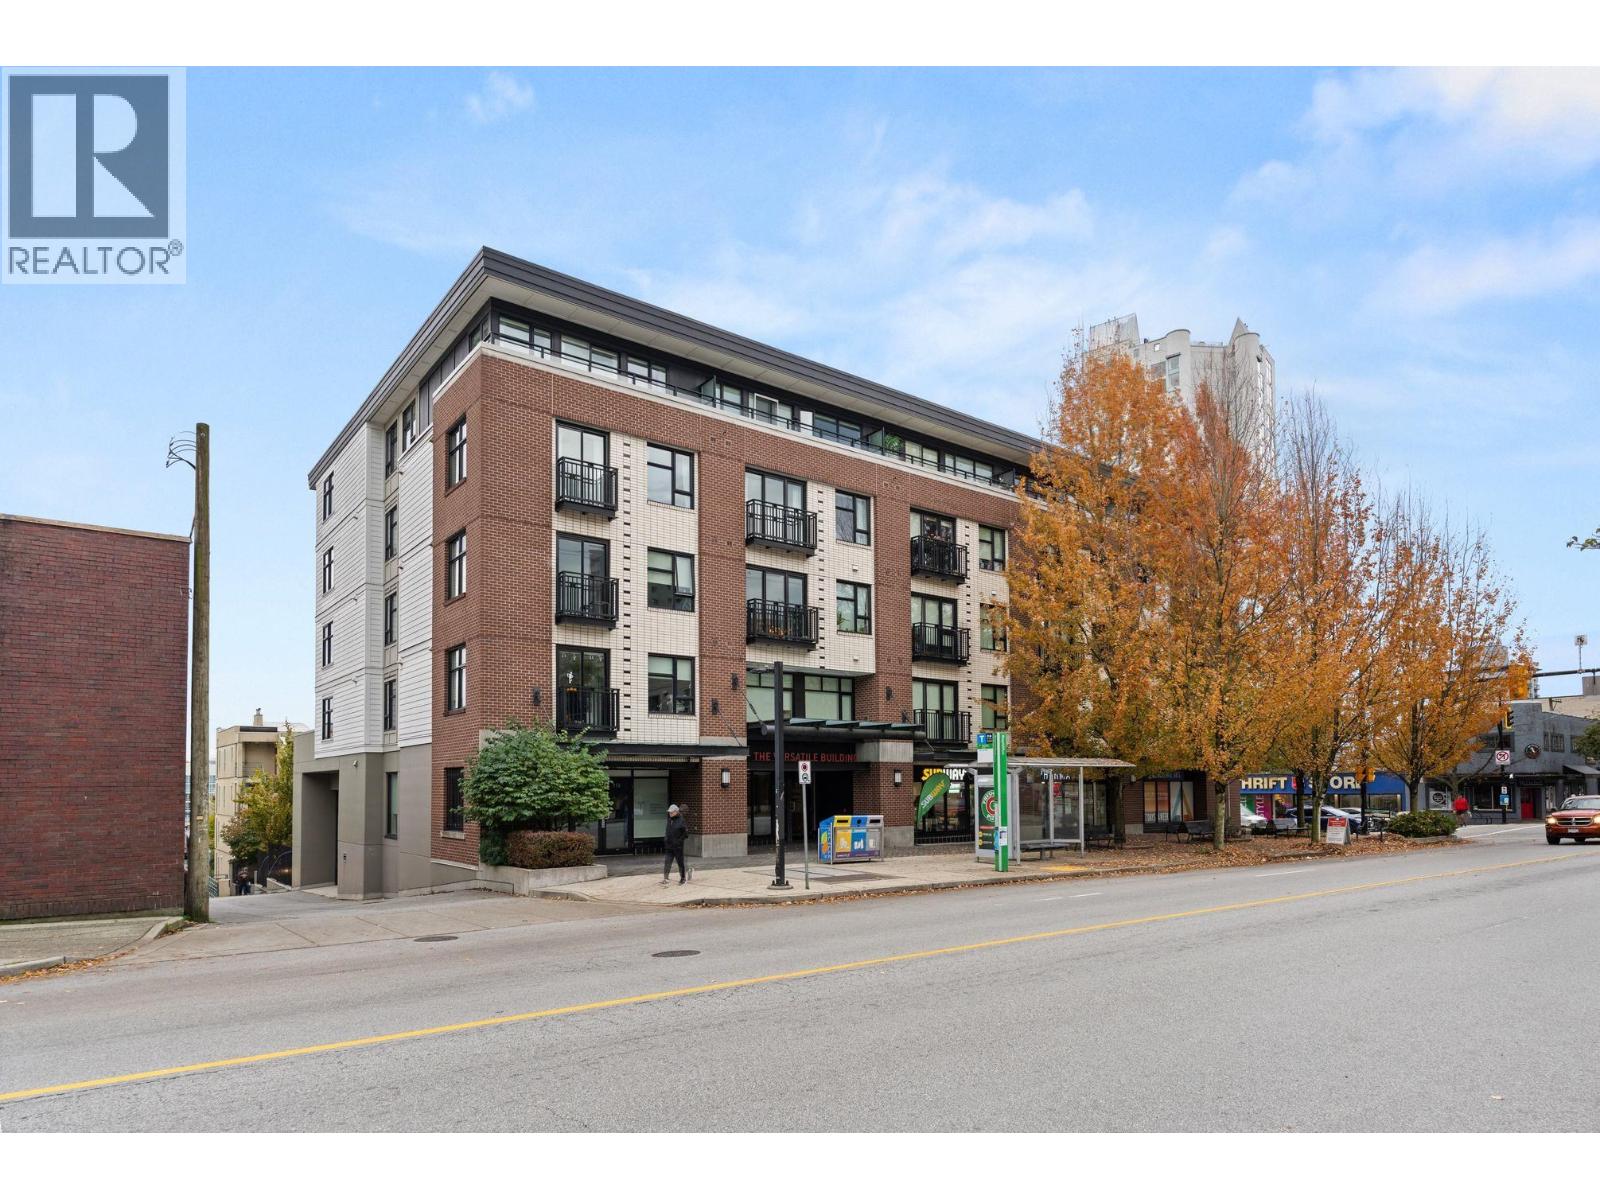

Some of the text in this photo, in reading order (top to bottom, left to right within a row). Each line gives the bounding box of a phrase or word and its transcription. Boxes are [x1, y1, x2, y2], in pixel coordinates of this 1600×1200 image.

[753, 752, 772, 761] THE
[773, 752, 819, 762] RSATILE
[1240, 776, 1288, 790] HRIFT
[920, 780, 945, 809] SUBWAY
